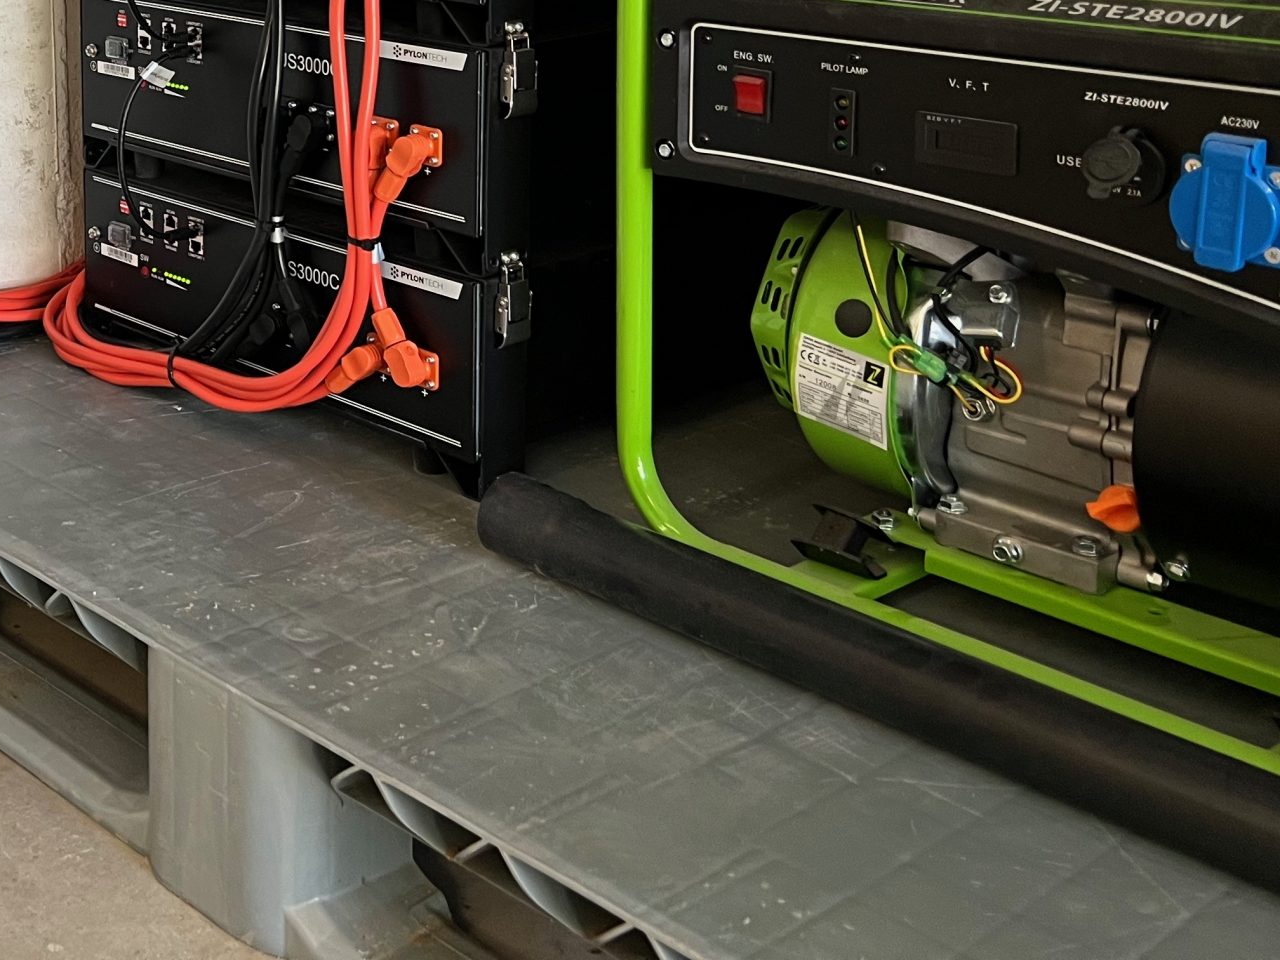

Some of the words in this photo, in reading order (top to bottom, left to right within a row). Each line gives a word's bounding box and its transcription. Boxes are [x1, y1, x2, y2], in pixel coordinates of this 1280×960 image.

[403, 48, 447, 63] PYLONTECH
[733, 50, 755, 61] ENG.
[284, 53, 334, 76] S3000
[717, 64, 727, 72] ON
[821, 62, 844, 72] PILOT
[845, 66, 868, 75] LAMP
[715, 104, 728, 112] OFF
[1084, 91, 1169, 110] ZI-STE2800IV
[1221, 115, 1260, 130] AC230V
[287, 261, 340, 290] S3000C
[400, 271, 443, 290] PYLONTECH
